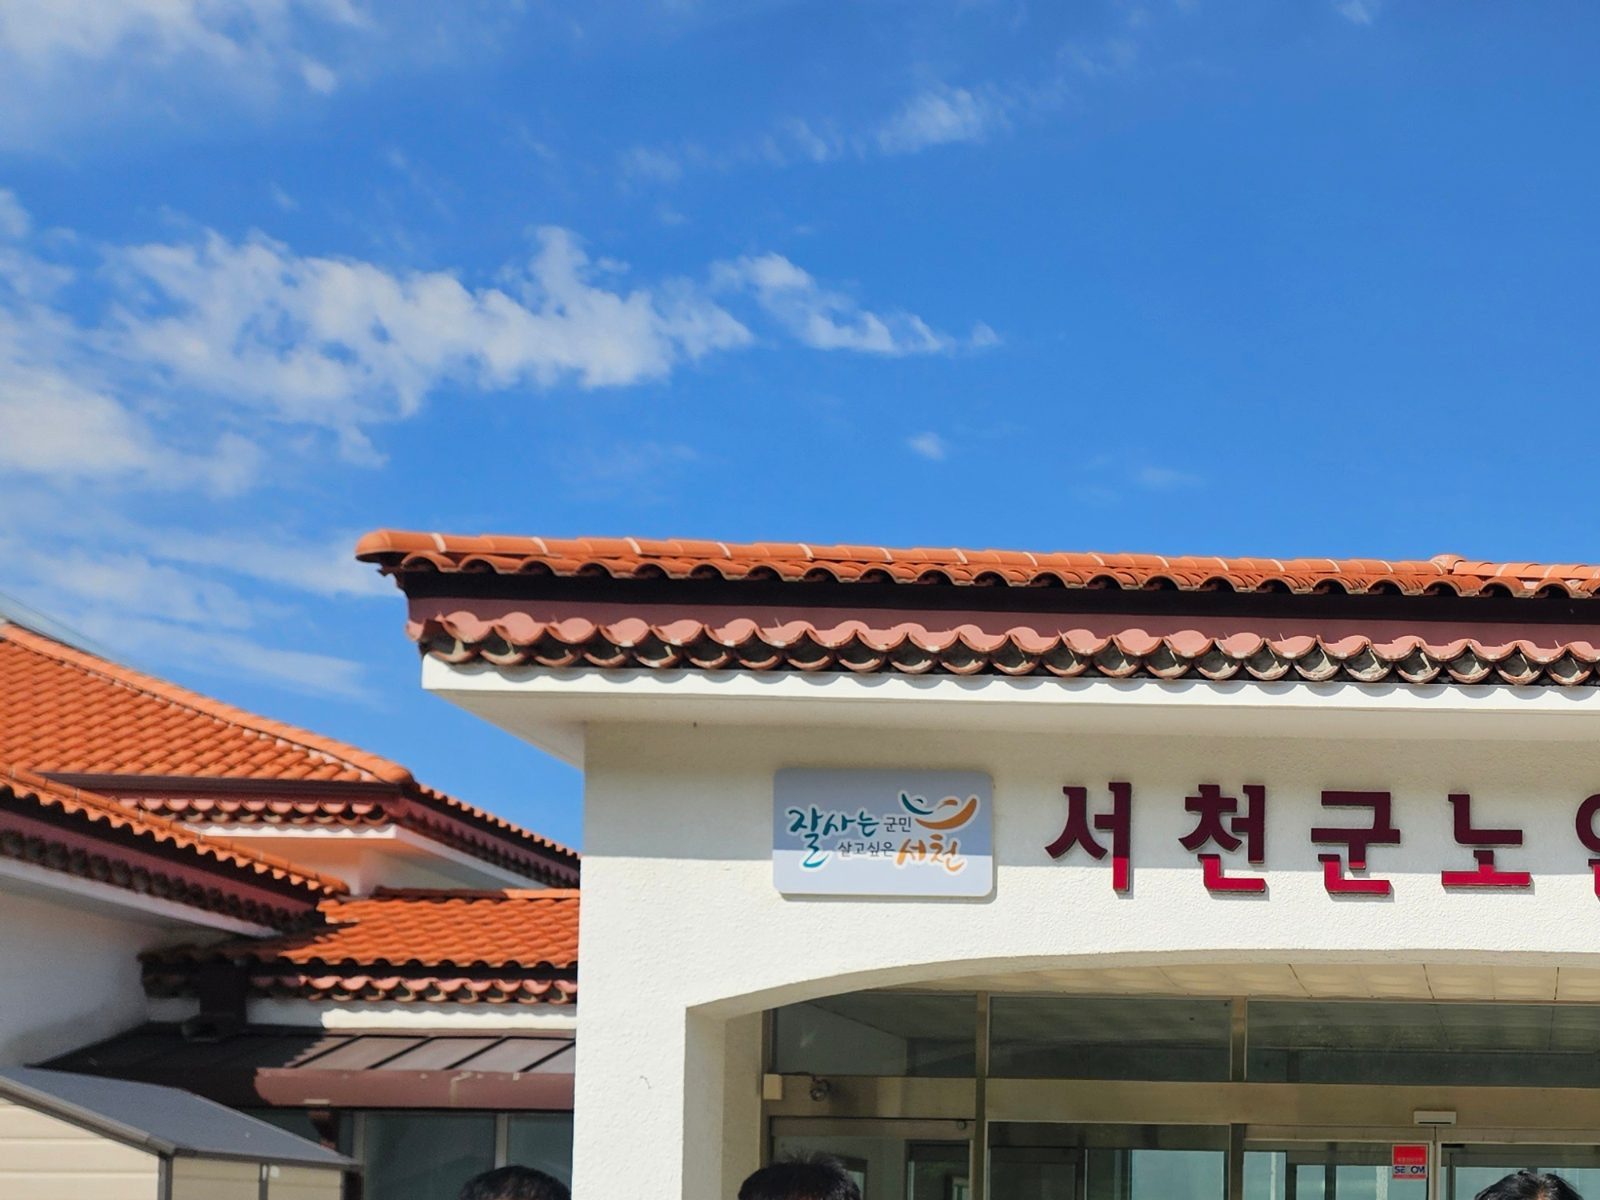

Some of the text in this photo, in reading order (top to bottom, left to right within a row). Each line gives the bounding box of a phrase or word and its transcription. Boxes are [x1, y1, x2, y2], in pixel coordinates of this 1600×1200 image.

[788, 807, 912, 868] 잘사는 군민
[838, 834, 964, 871] 살고싶은 서천
[1394, 1165, 1425, 1174] SEOM
